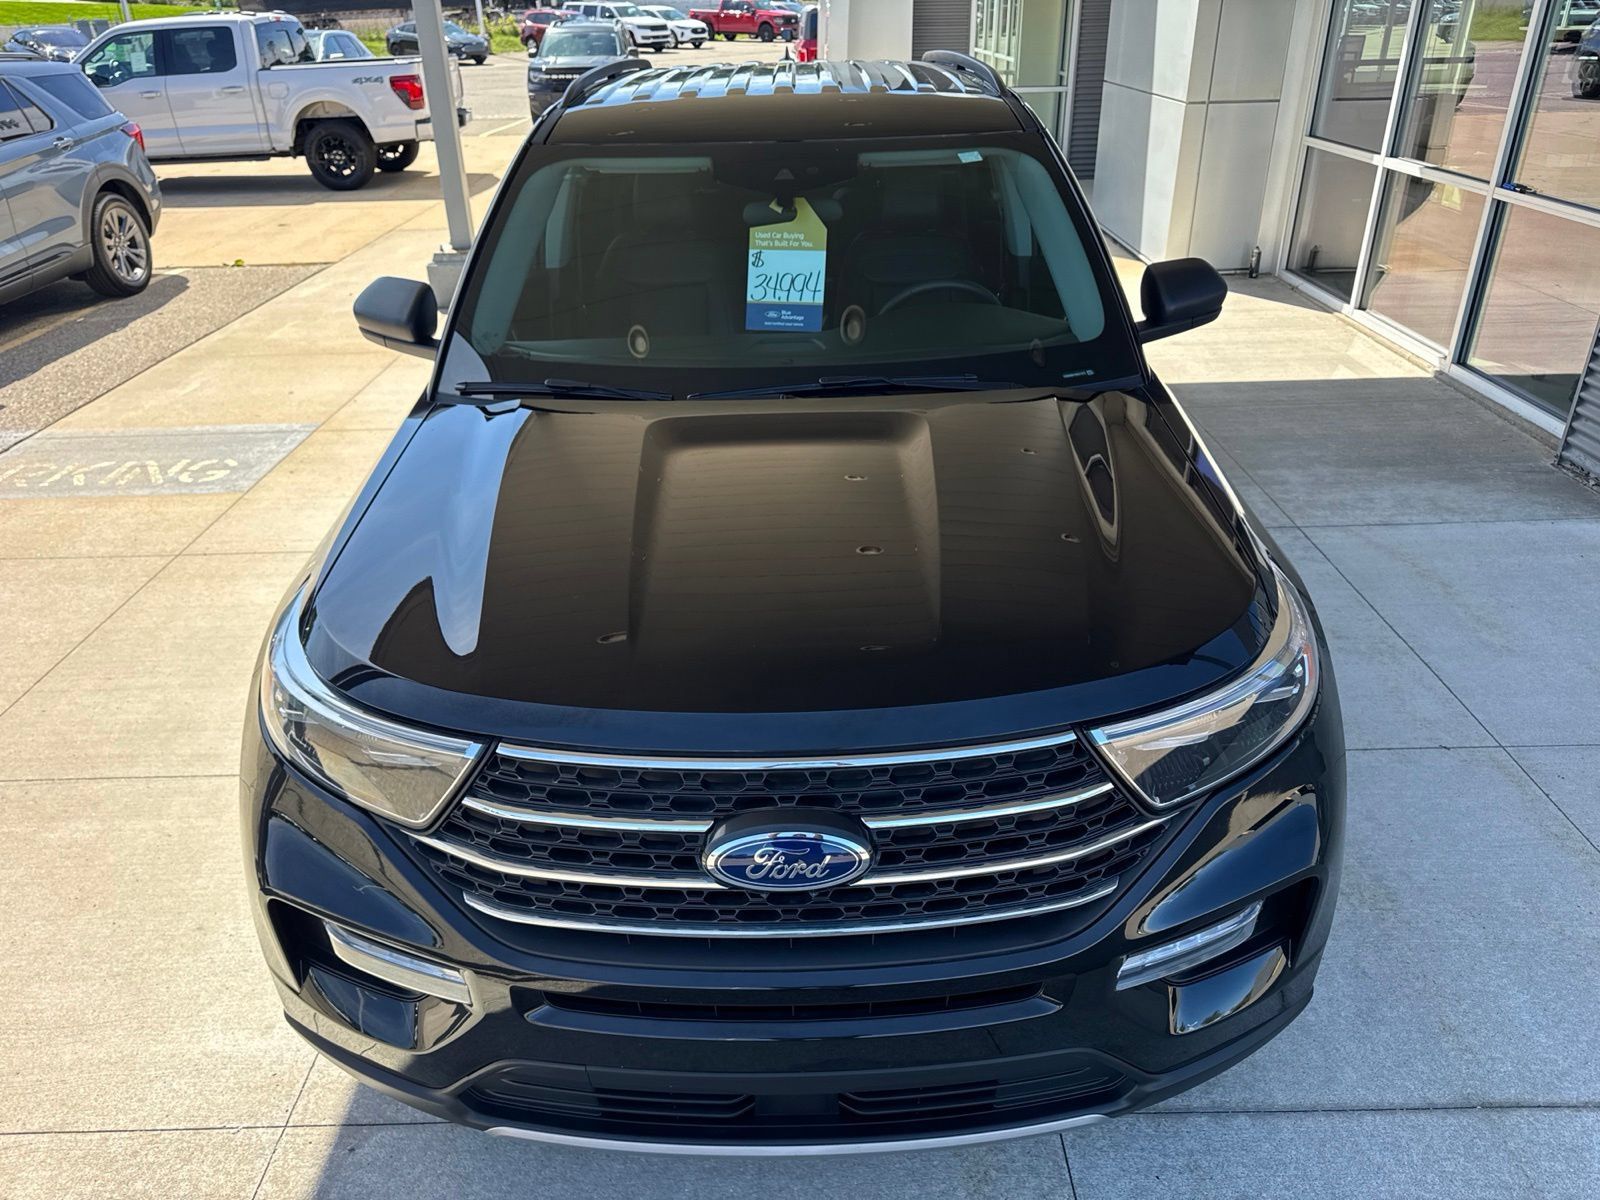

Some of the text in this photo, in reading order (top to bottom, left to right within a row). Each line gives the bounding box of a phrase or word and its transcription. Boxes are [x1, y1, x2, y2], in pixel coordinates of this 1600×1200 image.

[755, 231, 770, 239] Used
[783, 232, 804, 240] Buying
[745, 846, 831, 880] Ford
